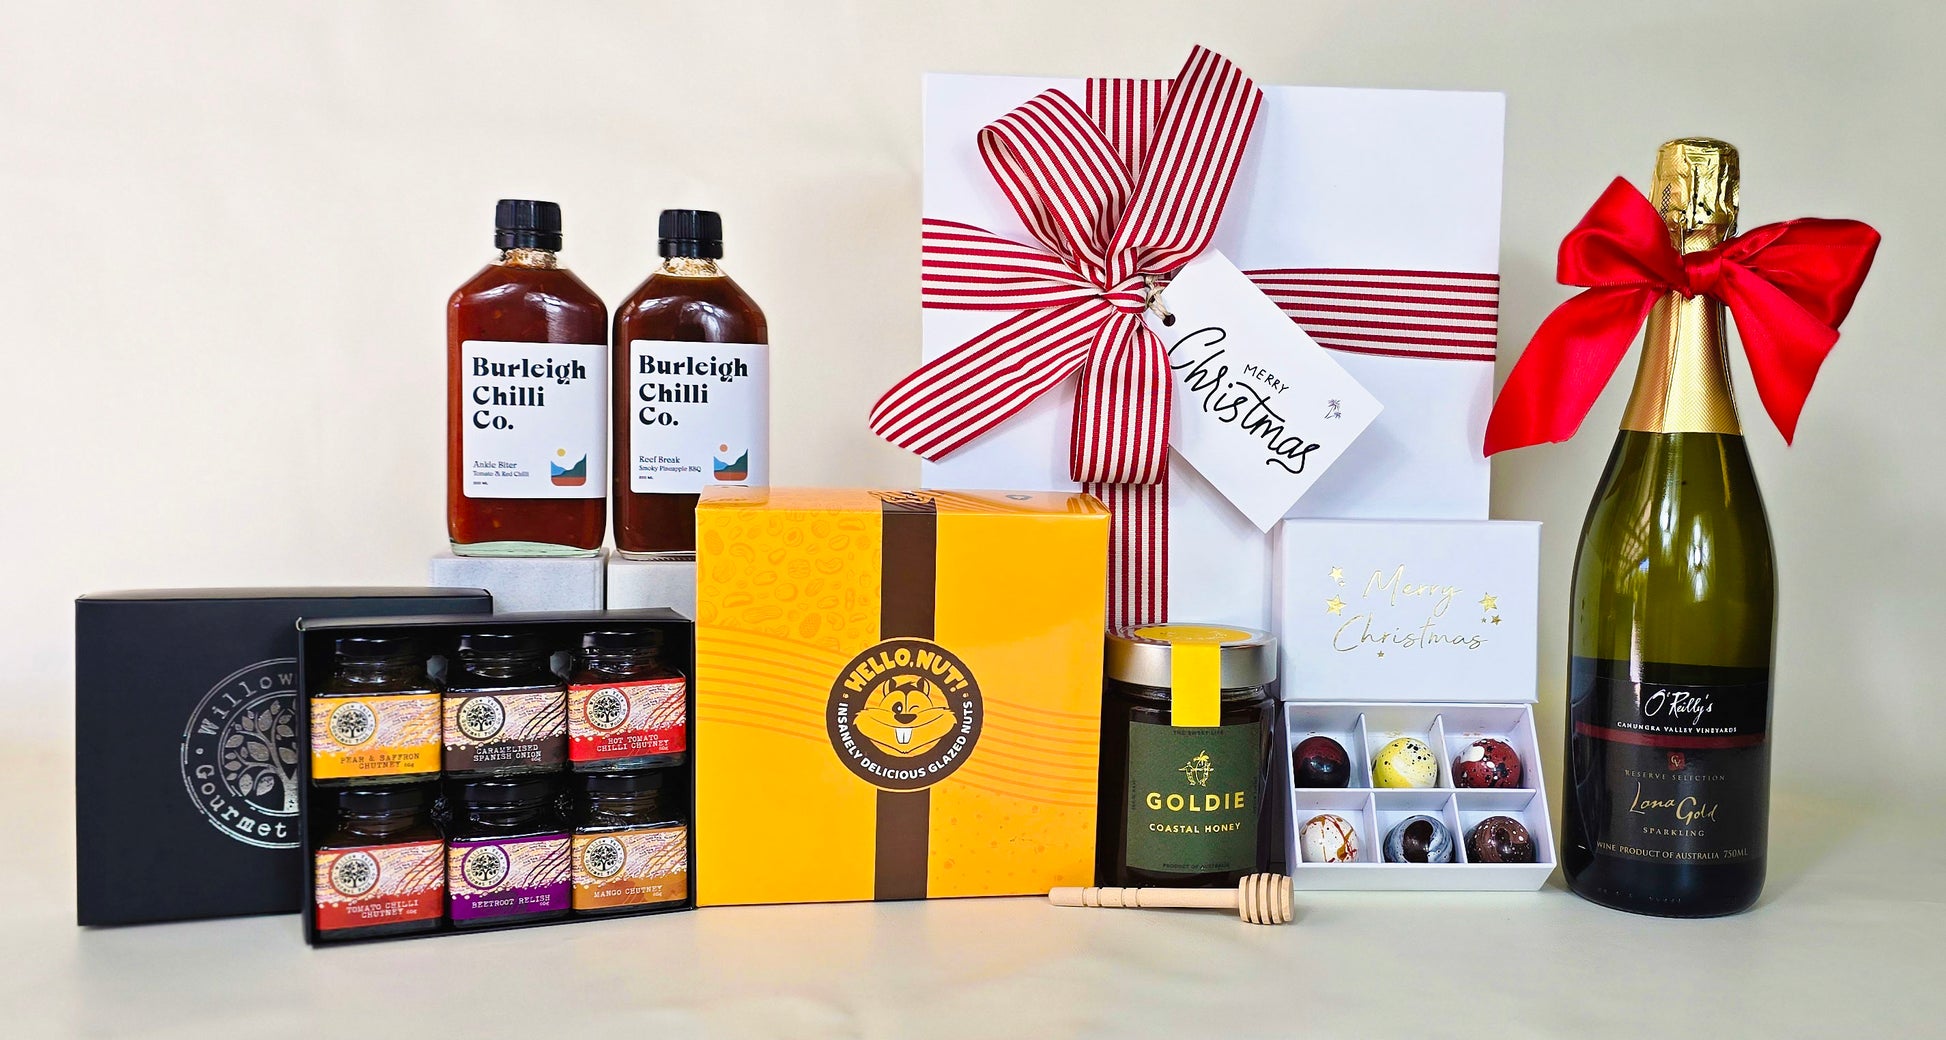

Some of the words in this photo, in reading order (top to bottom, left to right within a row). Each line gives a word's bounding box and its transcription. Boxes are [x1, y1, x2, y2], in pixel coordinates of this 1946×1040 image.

[472, 356, 587, 385] Burleigh
[639, 354, 748, 382] Burleigh
[1244, 364, 1289, 394] MERRY
[472, 385, 545, 407] Chilli
[639, 383, 709, 404] Chilli
[1168, 327, 1320, 474] Christmas
[472, 410, 514, 430] Co.
[639, 406, 679, 426] Co.
[473, 460, 497, 469] Ankle
[498, 461, 518, 469] Biter
[639, 455, 657, 463] Reef
[1362, 564, 1463, 618] Merry
[1332, 612, 1488, 652] Christmas
[843, 648, 914, 693] HELLO,
[916, 649, 969, 693] NUT!
[198, 672, 293, 736] Willow
[1644, 689, 1714, 725] O'Reilly's
[1617, 721, 1661, 732] CANUNGRA
[1664, 726, 1693, 734] VALLEY
[1695, 726, 1737, 734] VINEYARDS
[596, 743, 628, 752] CHILLI
[631, 739, 669, 749] CHUTNEY
[627, 734, 659, 743] TOMATO
[837, 702, 863, 760] INSANELY
[860, 757, 927, 780] DELICIOUS
[928, 736, 967, 774] GLAZED
[961, 700, 974, 735] NUTS
[380, 753, 419, 761] SAFFRON
[473, 754, 512, 762] SPANISH
[516, 751, 542, 759] ONION
[476, 744, 539, 755] CARAMELISED
[359, 761, 401, 769] CHUTNEY
[1624, 769, 1666, 780] RESERVE
[196, 764, 288, 838] Gourmet
[1146, 791, 1245, 812] GOLDIE
[1675, 796, 1719, 825] Gold
[1149, 823, 1200, 834] COASTAL
[1205, 822, 1241, 833] HONEY
[1643, 826, 1705, 837] SPARKLING
[1596, 841, 1616, 852] WINE
[1619, 846, 1660, 858] PRODUCT
[1662, 850, 1674, 859] OF
[1675, 851, 1720, 860] AUSTRALIA
[1723, 849, 1749, 859] 750ML
[593, 889, 622, 898] MANGO
[625, 885, 662, 895] CHUTNEY
[346, 904, 381, 914] TOMATO
[385, 900, 419, 909] CHILLI
[472, 899, 514, 909] BEETROOT
[519, 894, 550, 904] RELISH
[361, 908, 403, 919] CHUTNEY
